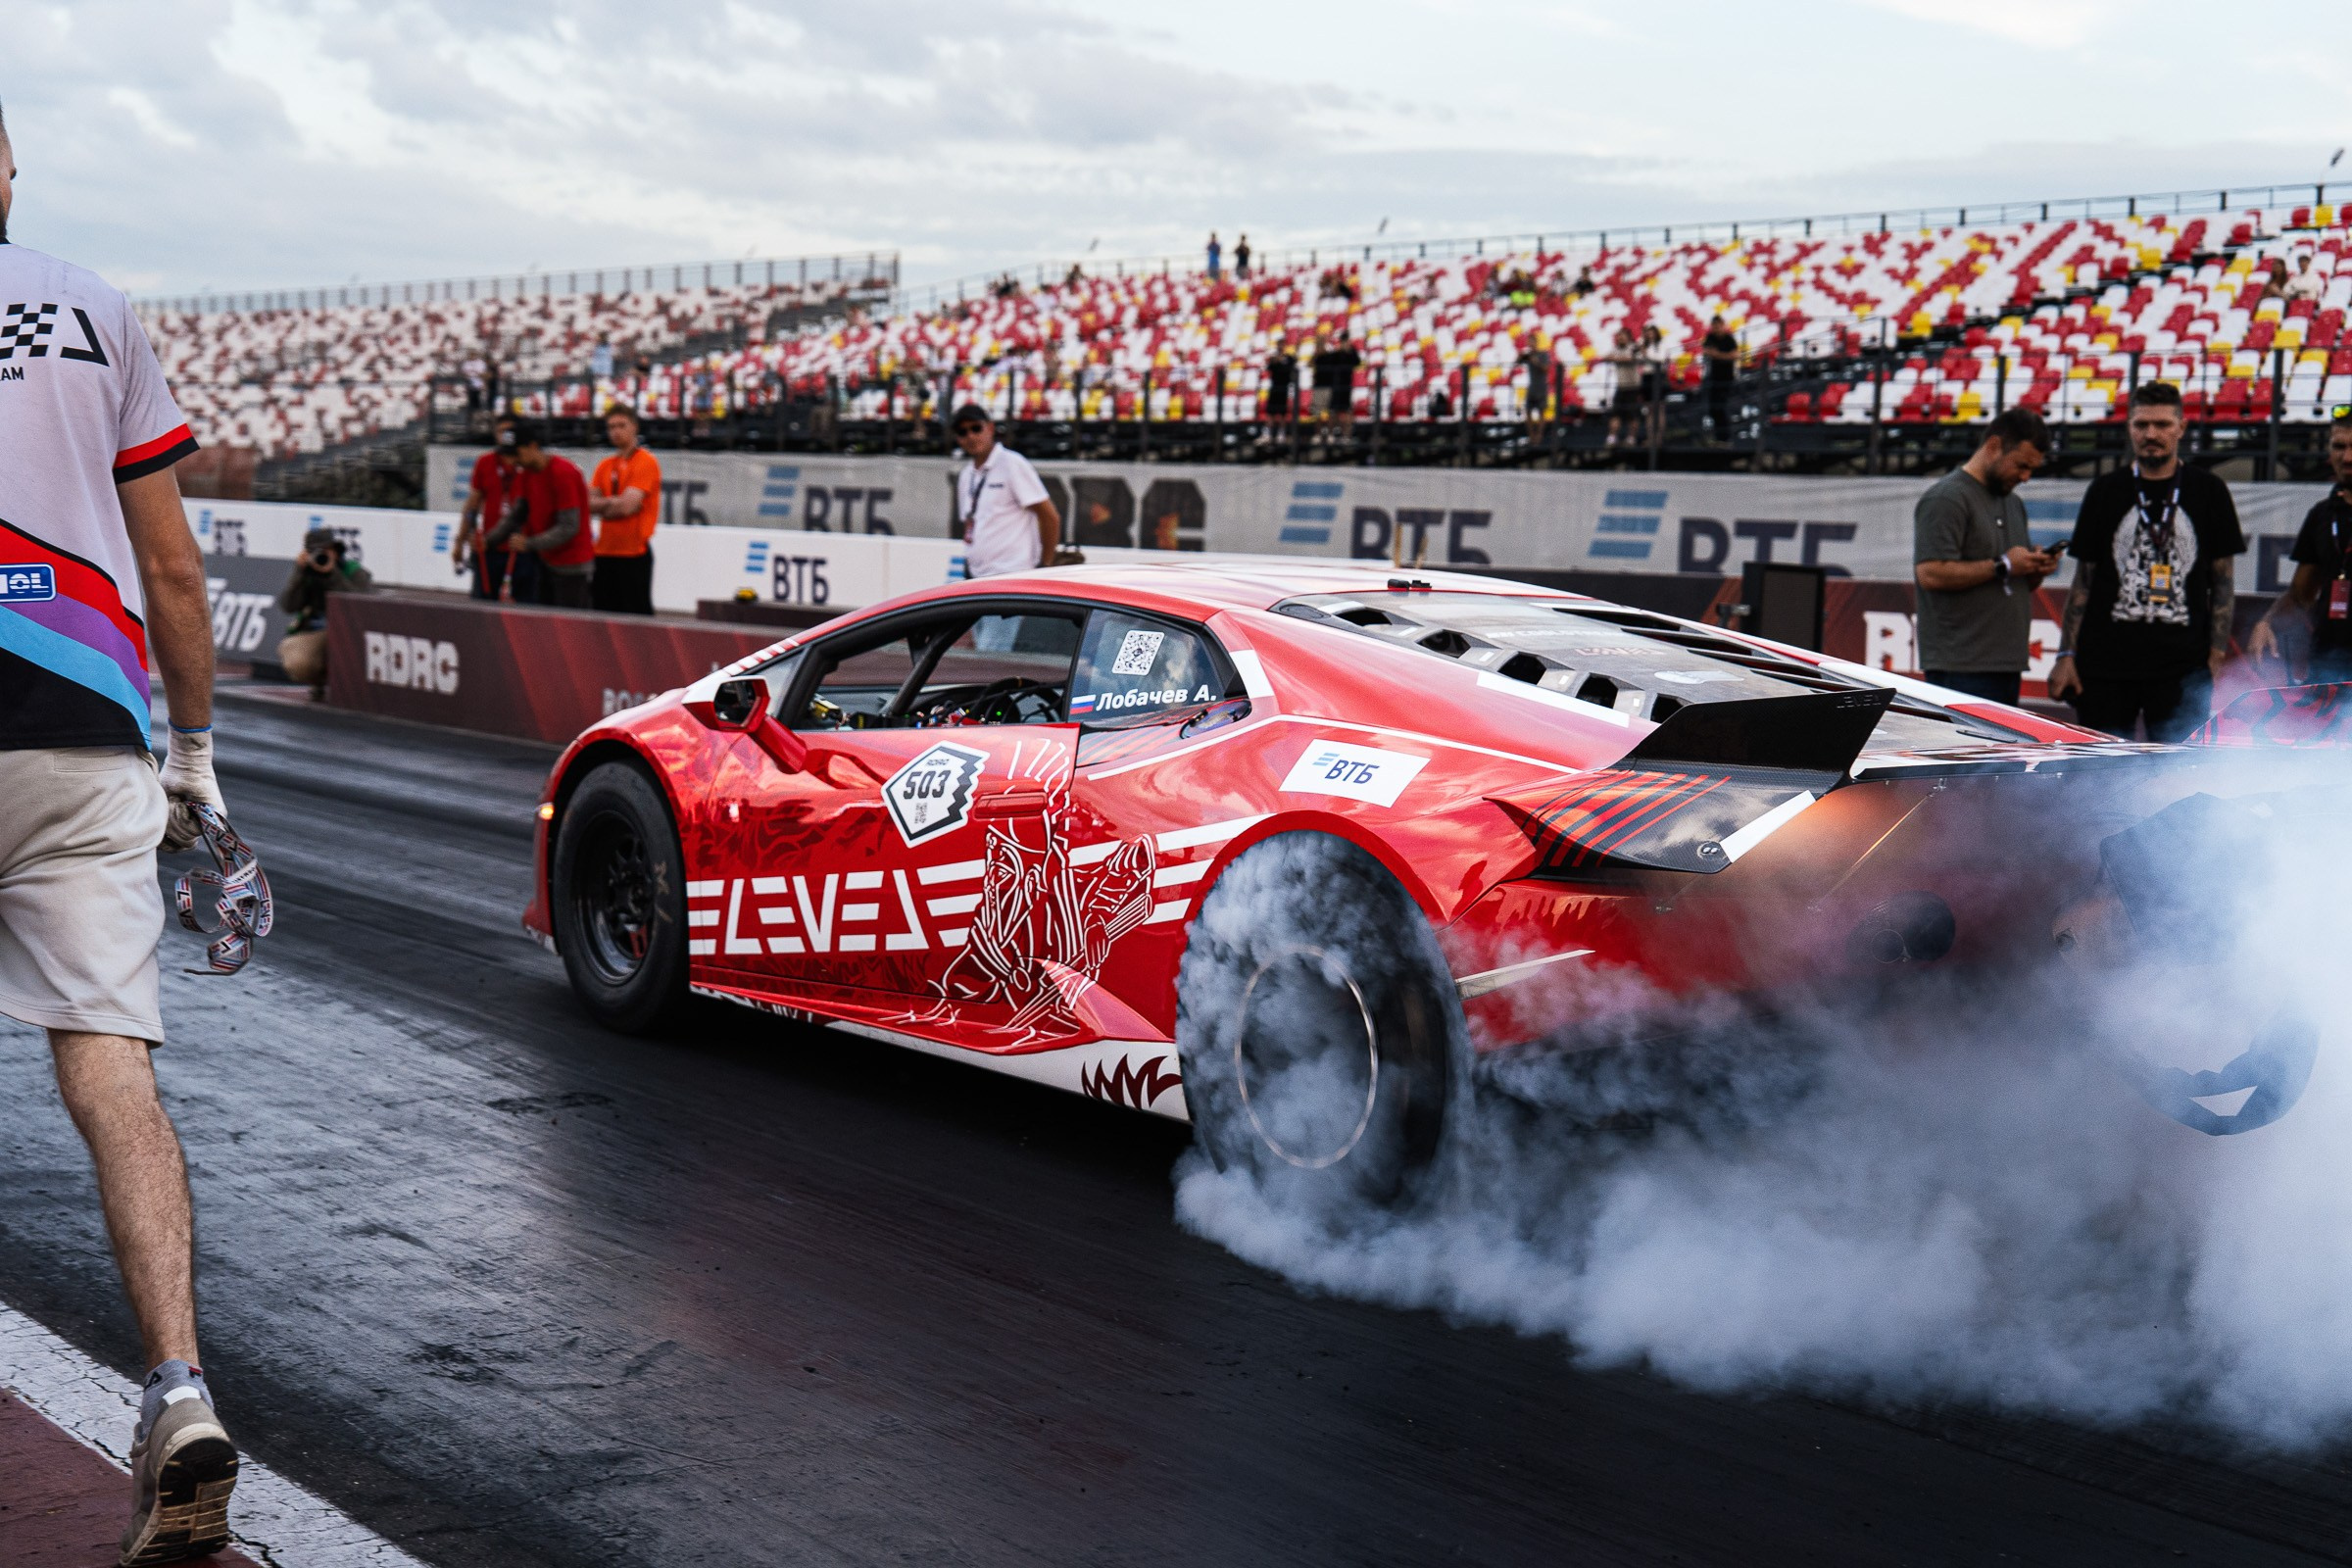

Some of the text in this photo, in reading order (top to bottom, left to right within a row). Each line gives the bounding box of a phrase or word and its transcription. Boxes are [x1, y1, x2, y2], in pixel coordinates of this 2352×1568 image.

[773, 555, 829, 606] ВТБ
[213, 592, 275, 653] ВТБ
[365, 630, 460, 696] RDRC
[1096, 684, 1217, 711] Лобачев А.
[903, 769, 952, 800] 503
[1325, 759, 1380, 785] ВТБ
